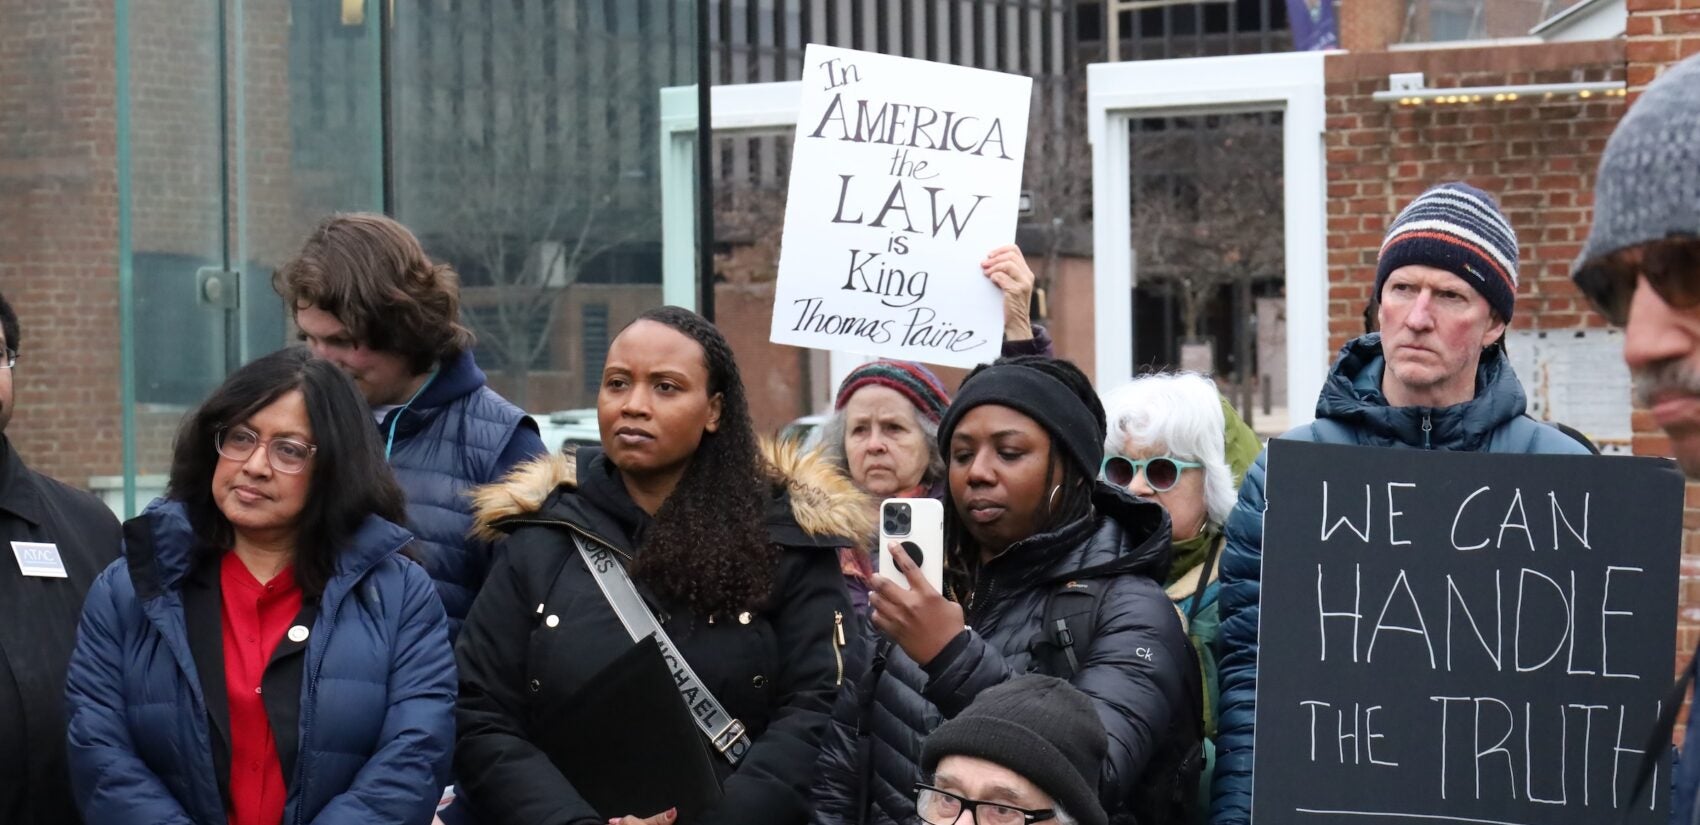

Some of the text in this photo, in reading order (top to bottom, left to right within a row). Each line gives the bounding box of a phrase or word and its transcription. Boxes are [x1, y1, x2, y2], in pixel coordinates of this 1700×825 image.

[819, 57, 862, 91] In
[807, 92, 1015, 160] AMERICA
[889, 148, 940, 180] the
[830, 174, 993, 241] LAW
[887, 231, 909, 255] is
[841, 249, 929, 308] King
[791, 297, 896, 344] Thomas
[1320, 480, 1592, 551] WE CAN
[581, 539, 614, 574] ORS
[1317, 562, 1643, 680] HANDLE
[1299, 696, 1662, 811] THE TRUTH
